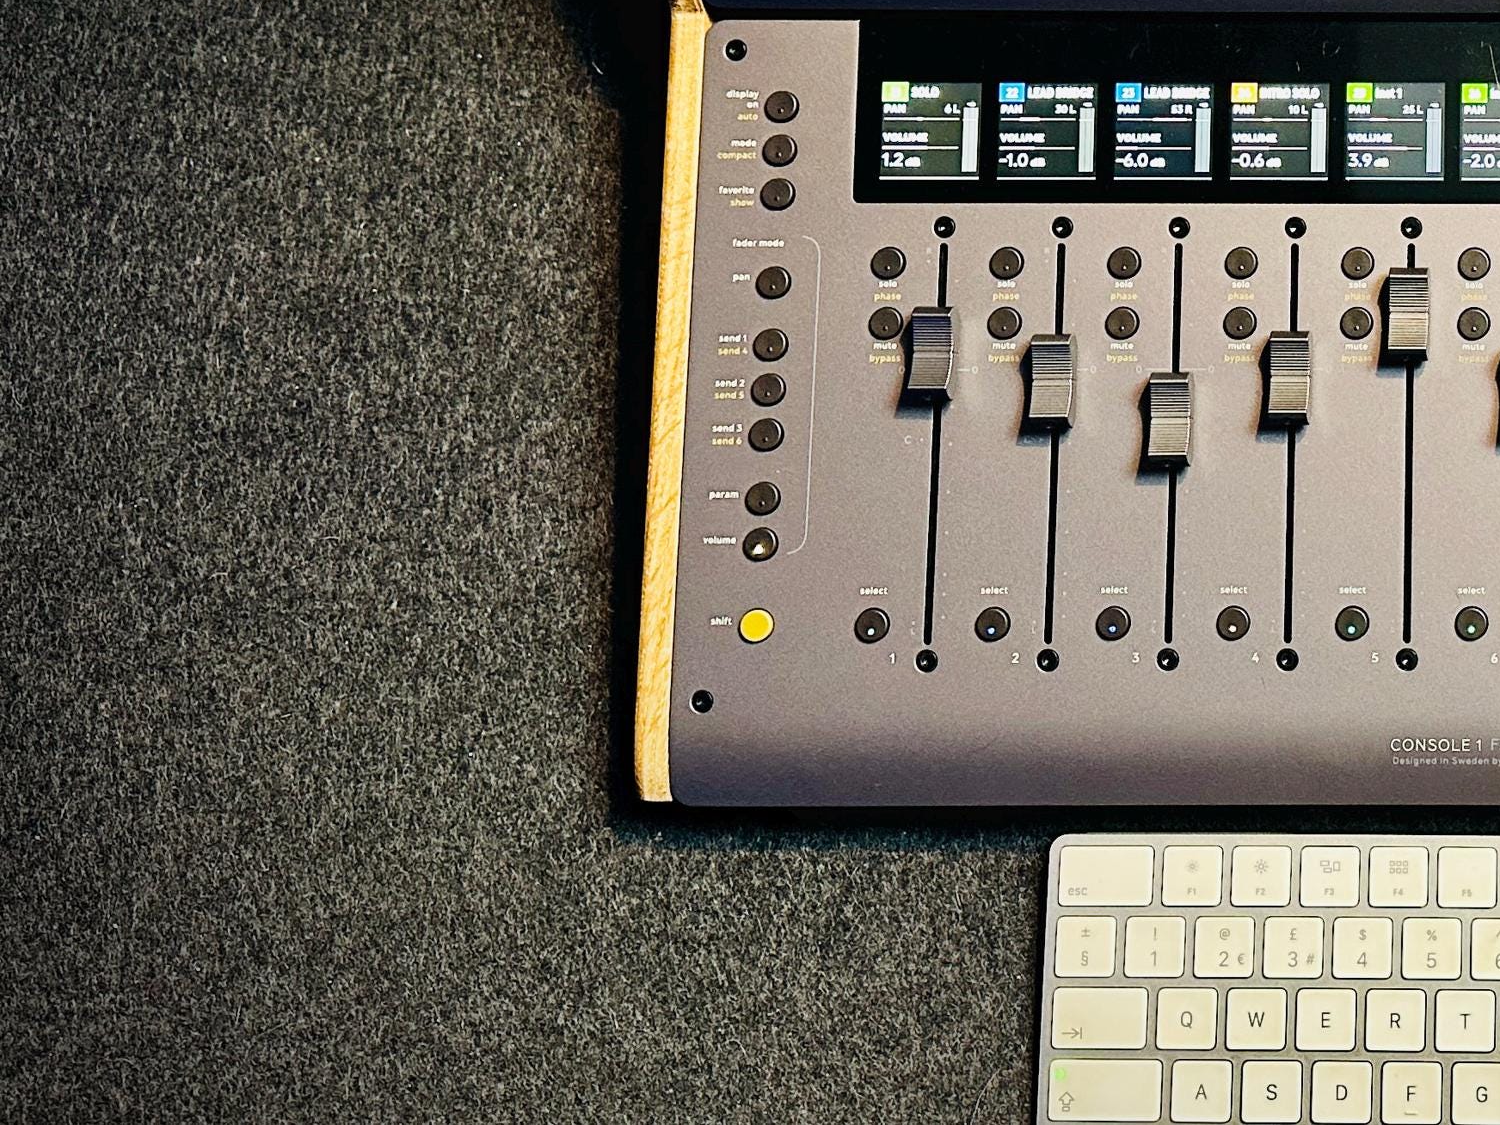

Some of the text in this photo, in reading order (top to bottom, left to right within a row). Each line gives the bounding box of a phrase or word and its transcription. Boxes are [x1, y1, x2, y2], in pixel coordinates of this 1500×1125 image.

[911, 86, 940, 99] SOLO
[1027, 86, 1054, 99] LEAD
[883, 104, 907, 114] PAN
[882, 132, 929, 143] VOLUME
[881, 152, 921, 168] 1.2 dB
[998, 152, 1046, 168] -1.0 dB
[1115, 153, 1149, 168] -6.0
[1231, 153, 1265, 168] -0.6
[1347, 153, 1373, 168] 3.9
[1462, 153, 1496, 169] -2.0
[718, 185, 755, 195] favorite
[732, 238, 785, 247] fader mode
[879, 280, 897, 288] solo
[874, 292, 902, 302] phase
[873, 342, 897, 350] mute
[869, 353, 901, 363] bypass
[709, 490, 739, 500] param
[703, 536, 737, 545] volume
[859, 586, 889, 595] select
[1132, 652, 1140, 664] 3
[1371, 652, 1379, 664] 5
[1390, 739, 1471, 752] CONSOLE
[1476, 739, 1483, 752] 1
[1392, 756, 1437, 766] Designed
[1439, 756, 1450, 765] in
[1451, 756, 1490, 765] Sweden
[1068, 887, 1088, 896] esc
[1219, 952, 1229, 967] 2
[1357, 953, 1368, 968] 4
[1180, 1011, 1193, 1029] Q
[1247, 1012, 1265, 1028] W
[1321, 1012, 1331, 1028] E
[1390, 1013, 1401, 1029] R
[1195, 1084, 1207, 1100] A
[1266, 1084, 1278, 1101] S
[1336, 1084, 1348, 1101] D
[1475, 1086, 1488, 1103] G
